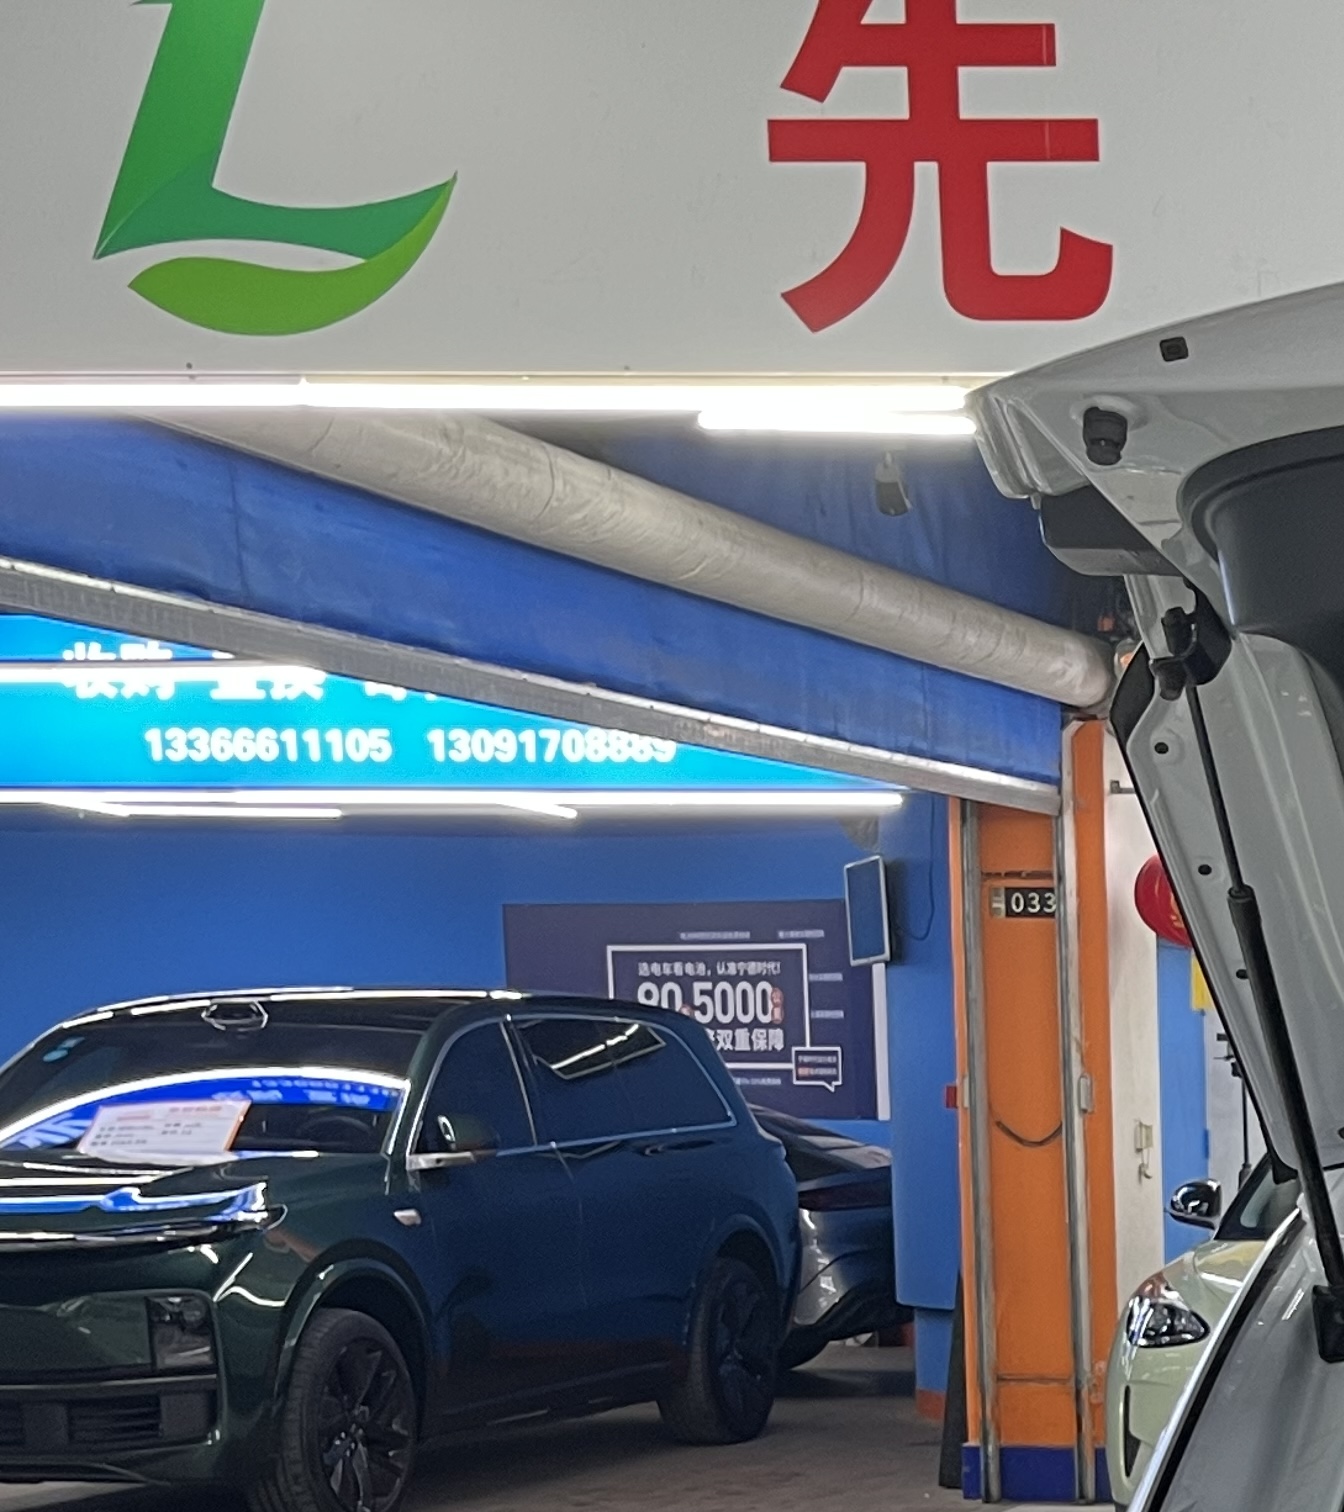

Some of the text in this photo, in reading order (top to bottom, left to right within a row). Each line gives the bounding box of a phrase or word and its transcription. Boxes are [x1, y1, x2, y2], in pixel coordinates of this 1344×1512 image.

[144, 727, 393, 763] 13366611105
[1010, 891, 1057, 914] 033
[706, 1028, 785, 1051] 双重保障
